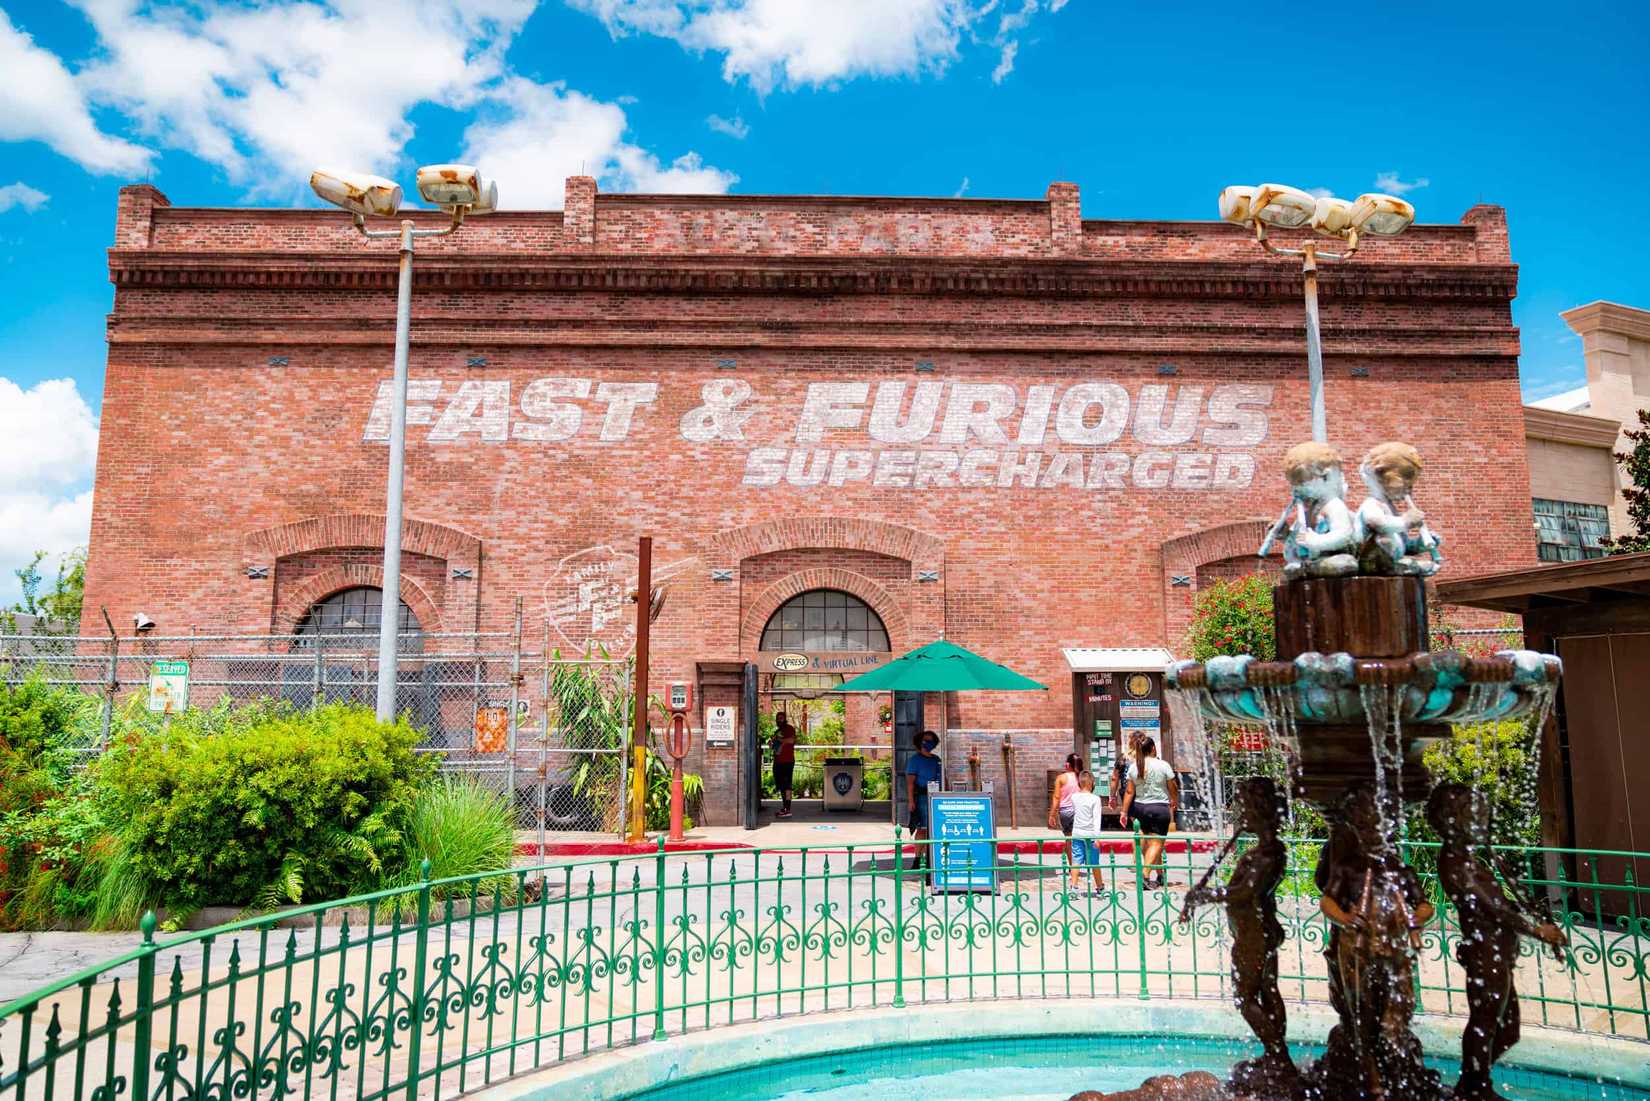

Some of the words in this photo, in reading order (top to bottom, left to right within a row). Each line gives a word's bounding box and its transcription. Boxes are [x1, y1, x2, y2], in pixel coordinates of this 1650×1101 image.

[362, 375, 658, 443] FAST
[678, 377, 757, 443] &
[794, 379, 1275, 447] FURIOUS
[741, 448, 1257, 490] SUPERCHARGED
[775, 657, 806, 669] EXPRESS
[824, 657, 859, 669] VIRTUAL
[861, 656, 879, 665] LINE
